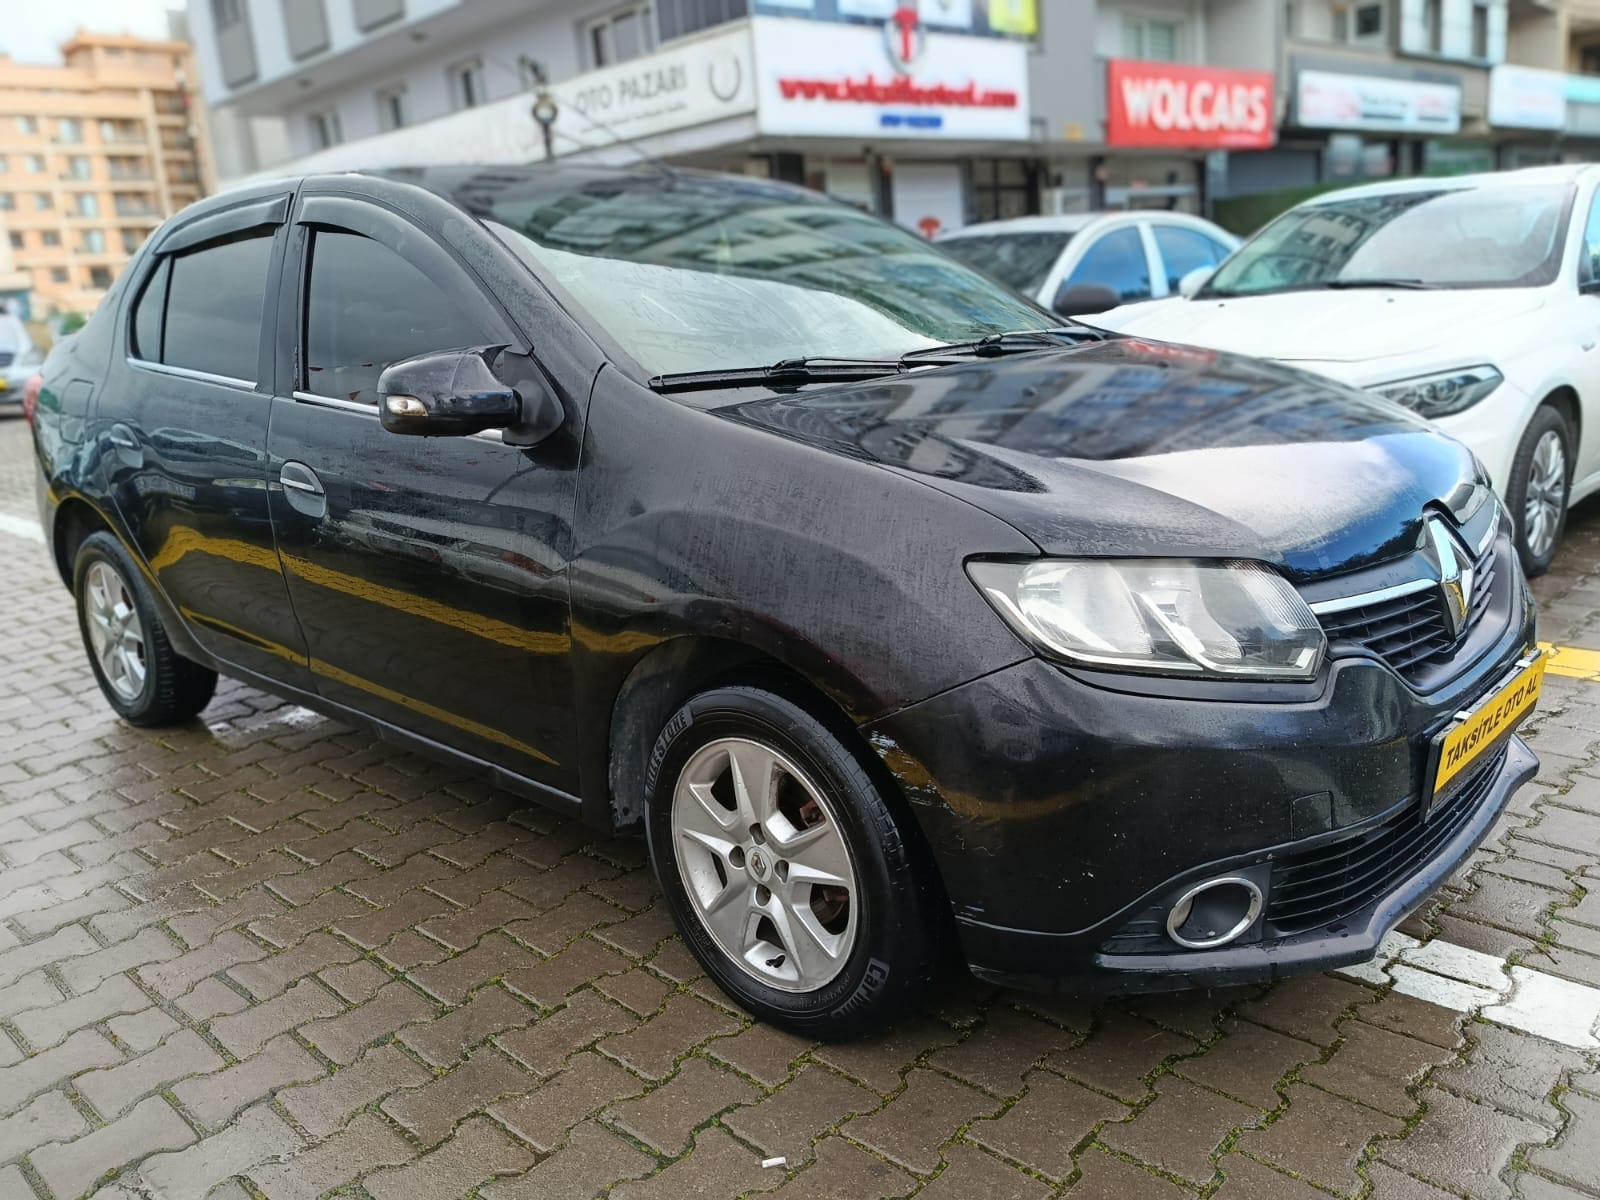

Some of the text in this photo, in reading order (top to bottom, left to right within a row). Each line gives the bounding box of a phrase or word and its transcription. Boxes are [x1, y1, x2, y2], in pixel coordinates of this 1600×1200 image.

[576, 64, 688, 115] OTO PAZARI
[1121, 77, 1267, 133] WOLCARS
[1446, 674, 1538, 770] TAKSİTLE OTO AL
